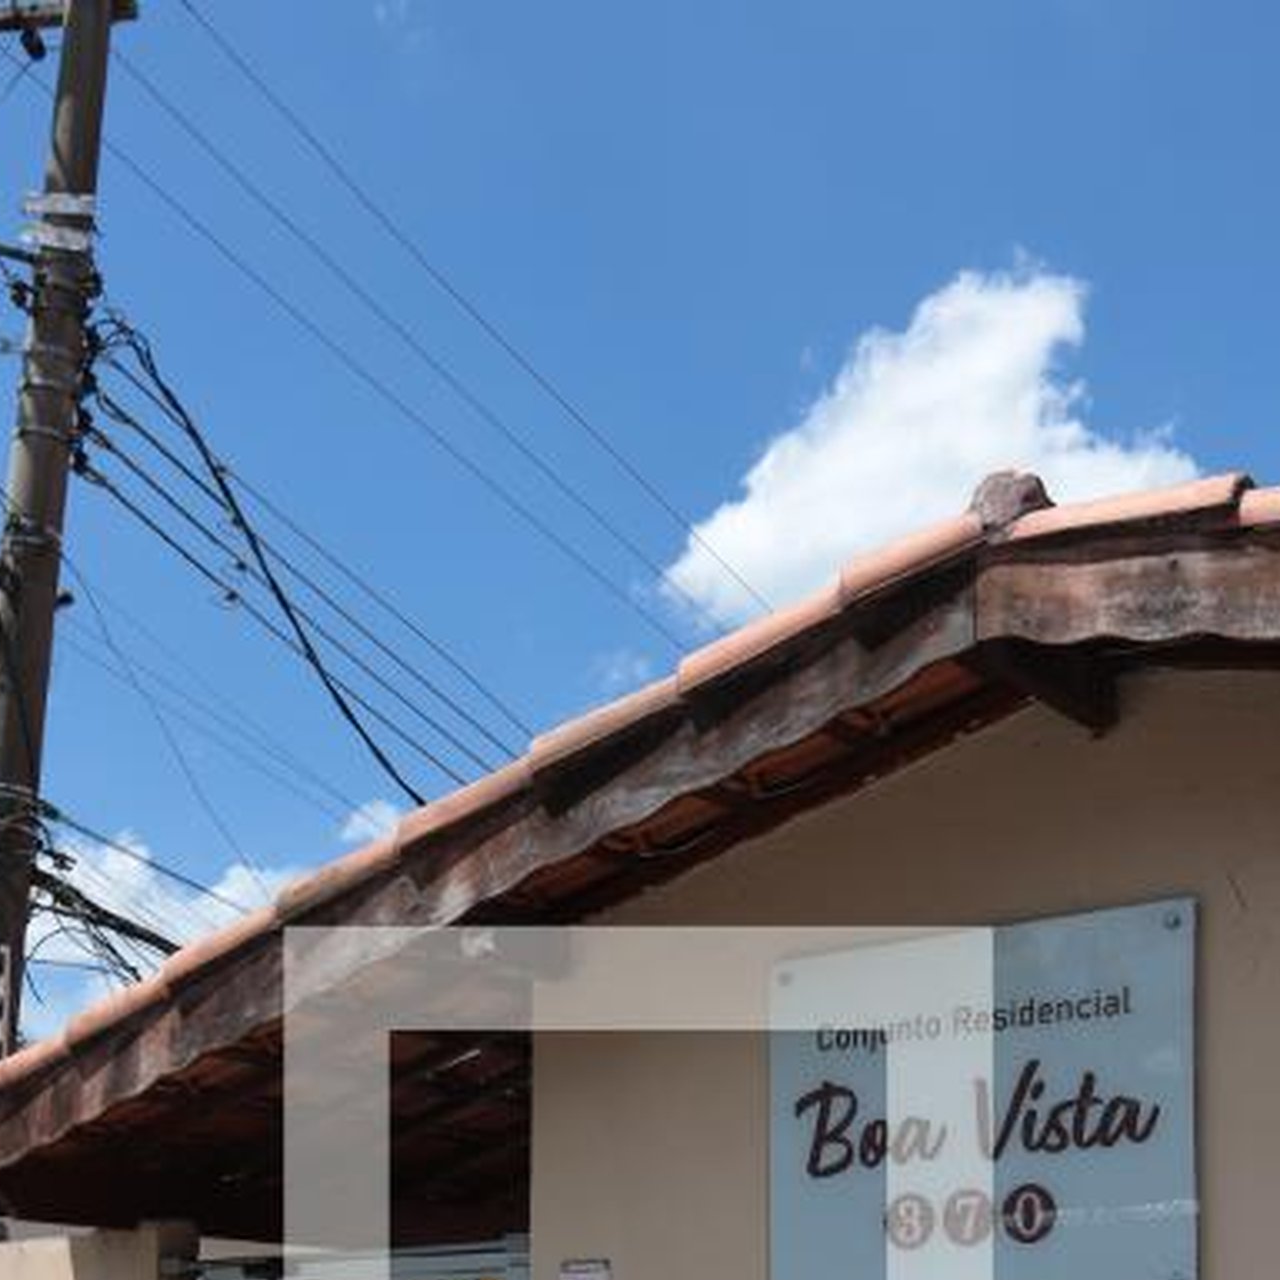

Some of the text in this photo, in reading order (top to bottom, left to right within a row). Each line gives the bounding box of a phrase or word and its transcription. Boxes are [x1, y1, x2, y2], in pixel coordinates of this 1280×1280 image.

[816, 985, 1131, 1052] Conjunto Residencial
[795, 1060, 1161, 1177] Boa Vista
